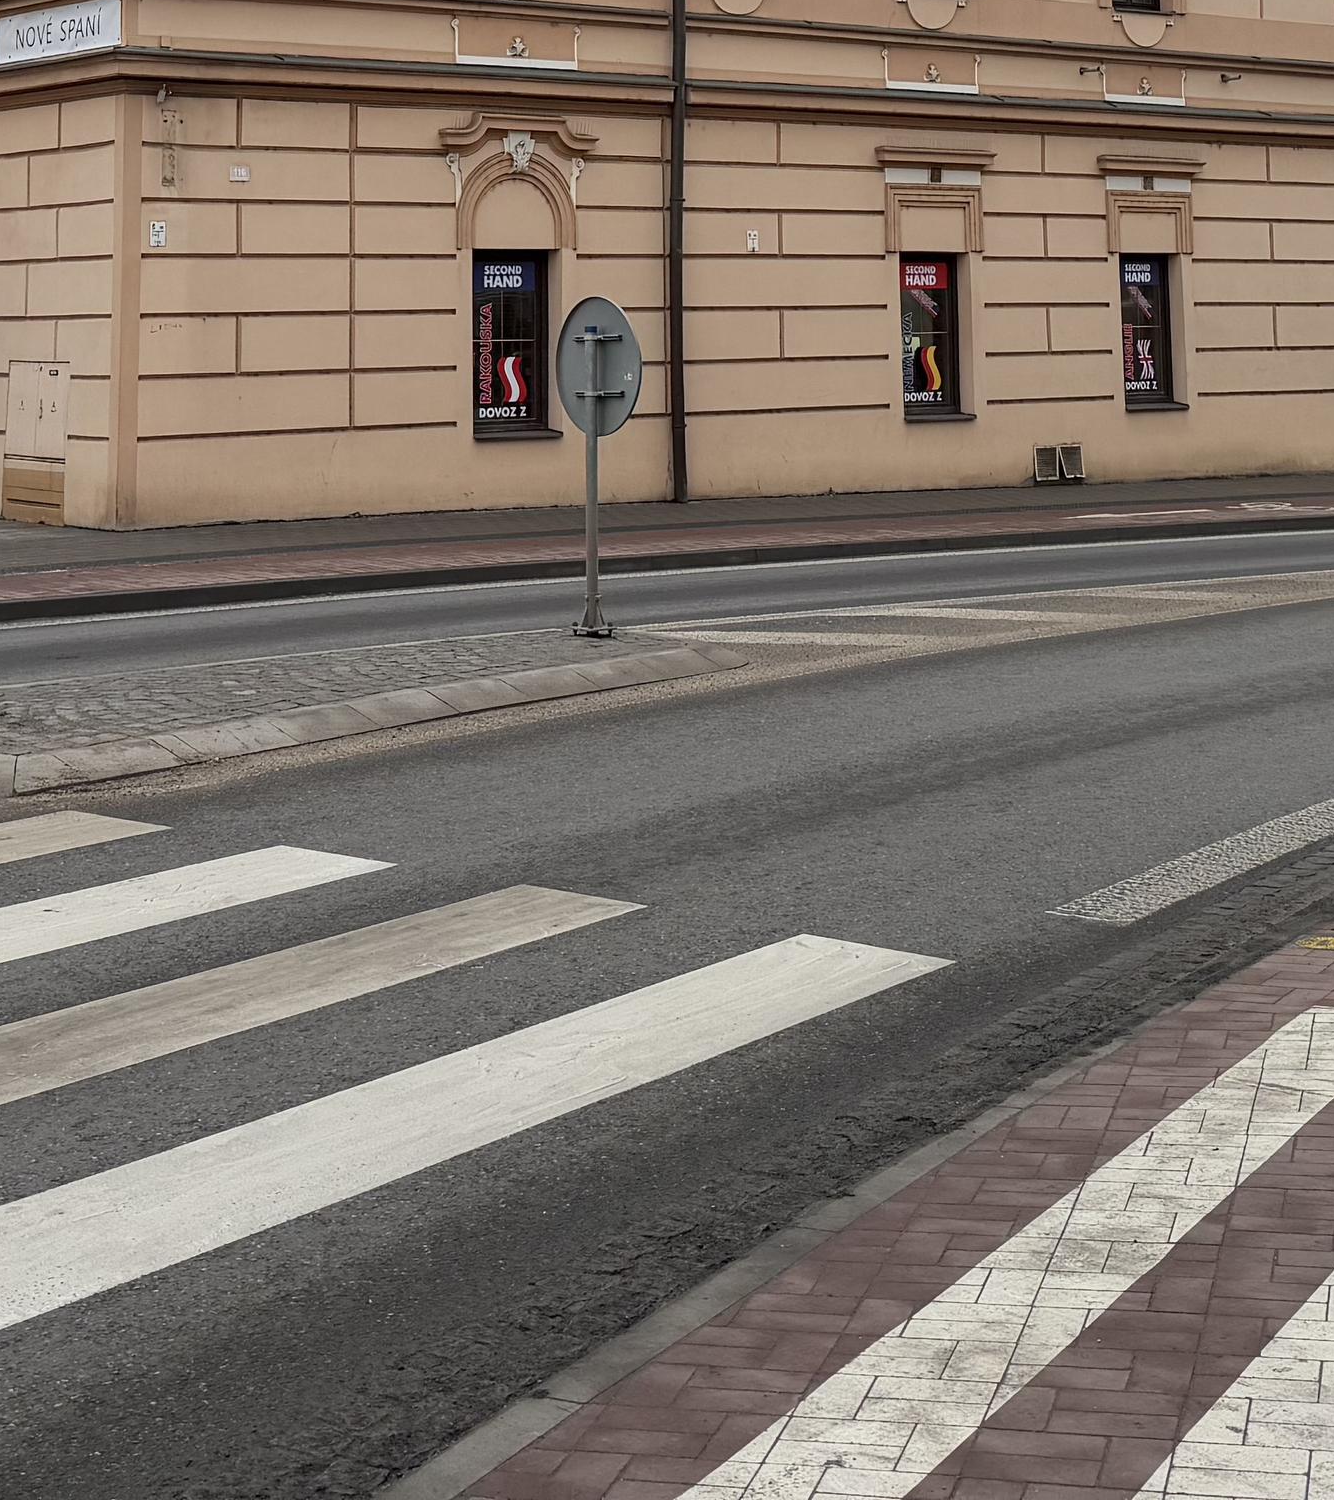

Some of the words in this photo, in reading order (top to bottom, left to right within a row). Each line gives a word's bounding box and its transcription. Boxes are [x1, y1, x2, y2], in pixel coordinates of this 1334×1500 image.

[15, 16, 53, 50] NOVÉ
[59, 7, 102, 42] SPANÍ
[483, 265, 523, 275] SECOND
[905, 265, 937, 275] SECOND
[1124, 263, 1151, 272] SECOND
[483, 275, 523, 288] HAND
[905, 275, 937, 286] HAND
[1124, 272, 1151, 283] HAND
[479, 302, 493, 405] RAKOUSKA
[1123, 323, 1135, 381] ANGLIE
[1125, 381, 1151, 390] DOVOZ
[1152, 381, 1158, 390] Z
[904, 392, 935, 402] DOVOZ
[936, 391, 942, 401] Z
[478, 407, 517, 419] DOVOZ
[519, 406, 527, 417] Z
